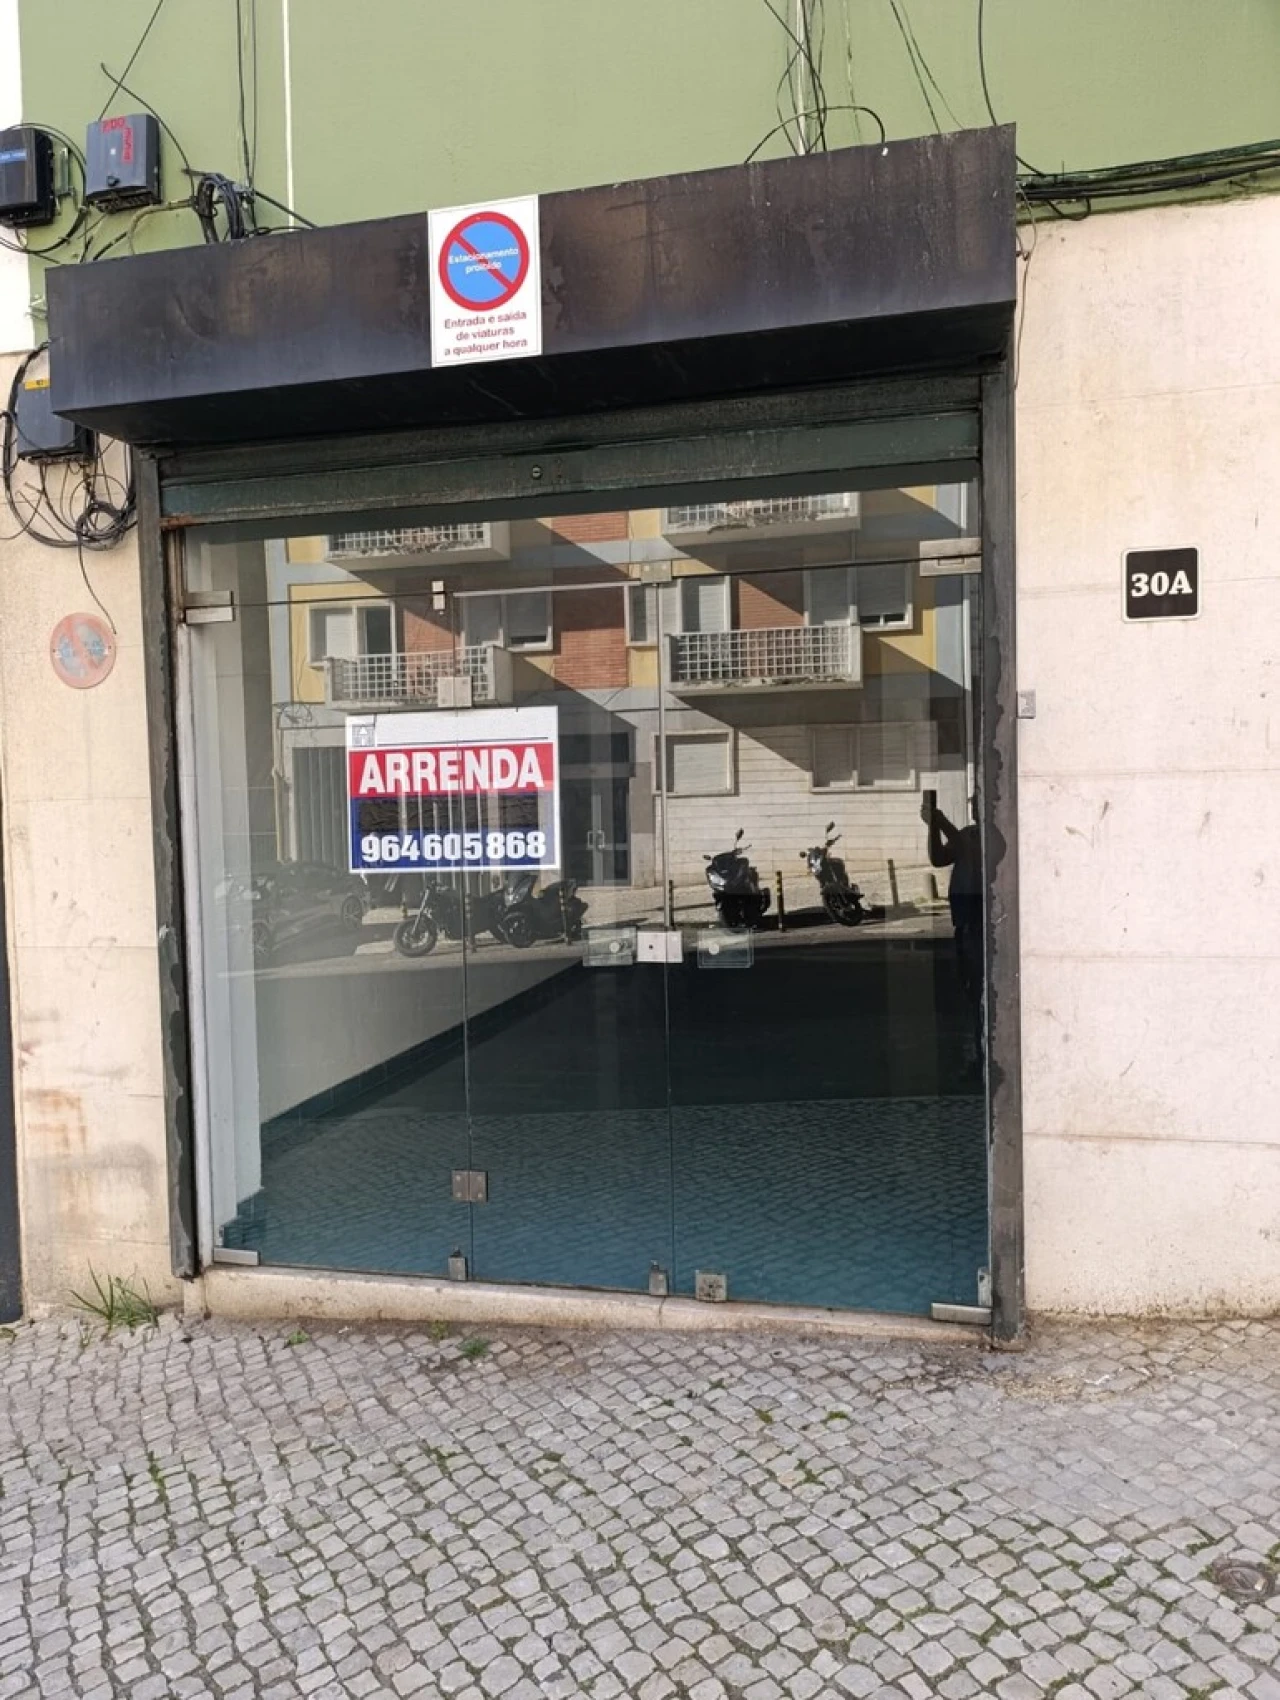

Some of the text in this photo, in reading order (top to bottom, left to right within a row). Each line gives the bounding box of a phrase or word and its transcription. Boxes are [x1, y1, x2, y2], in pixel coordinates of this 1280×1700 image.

[449, 249, 518, 264] Estacionamento
[444, 315, 486, 329] Entrada
[488, 316, 496, 324] e
[456, 327, 515, 341] de viaturas
[444, 338, 528, 356] a qualquer hora
[1131, 570, 1193, 598] 30A
[359, 747, 545, 794] ARRENDA
